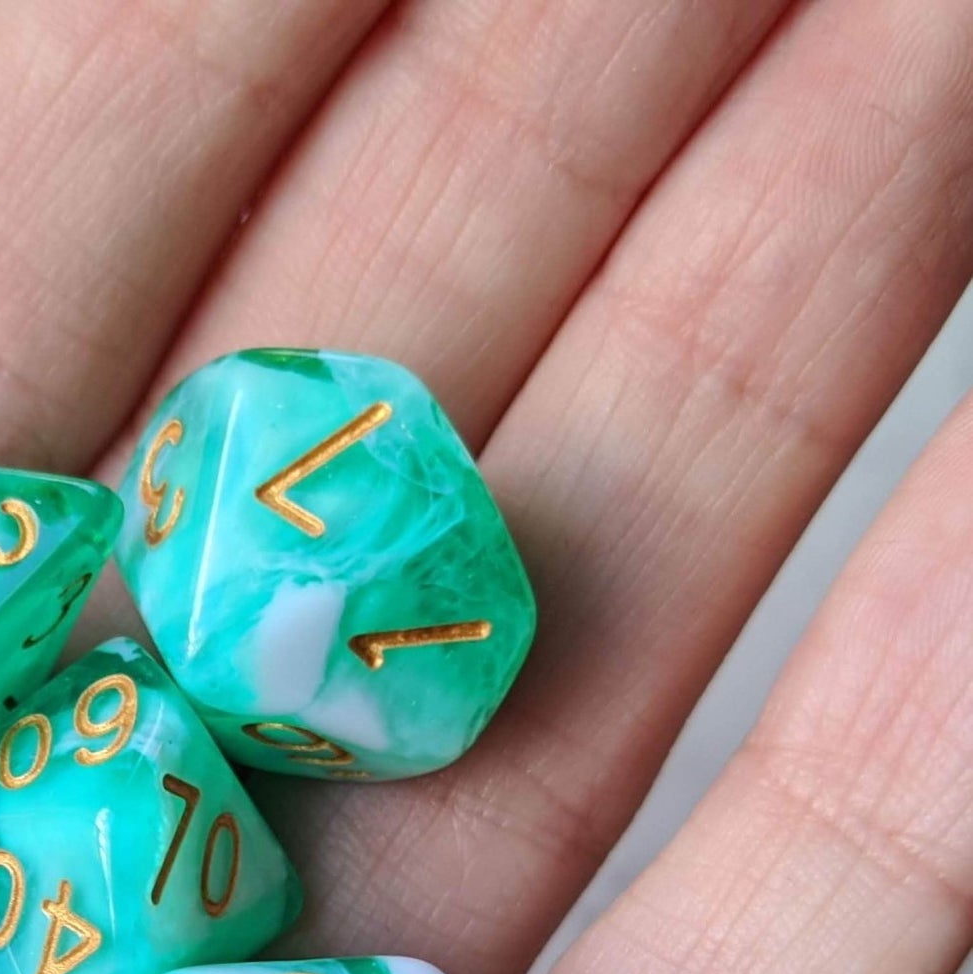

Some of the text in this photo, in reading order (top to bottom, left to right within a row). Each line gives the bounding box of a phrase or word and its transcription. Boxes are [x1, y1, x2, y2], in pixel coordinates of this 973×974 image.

[141, 420, 185, 548] 3
[255, 402, 393, 538] 7
[347, 619, 493, 671] 1
[151, 773, 241, 919] 70
